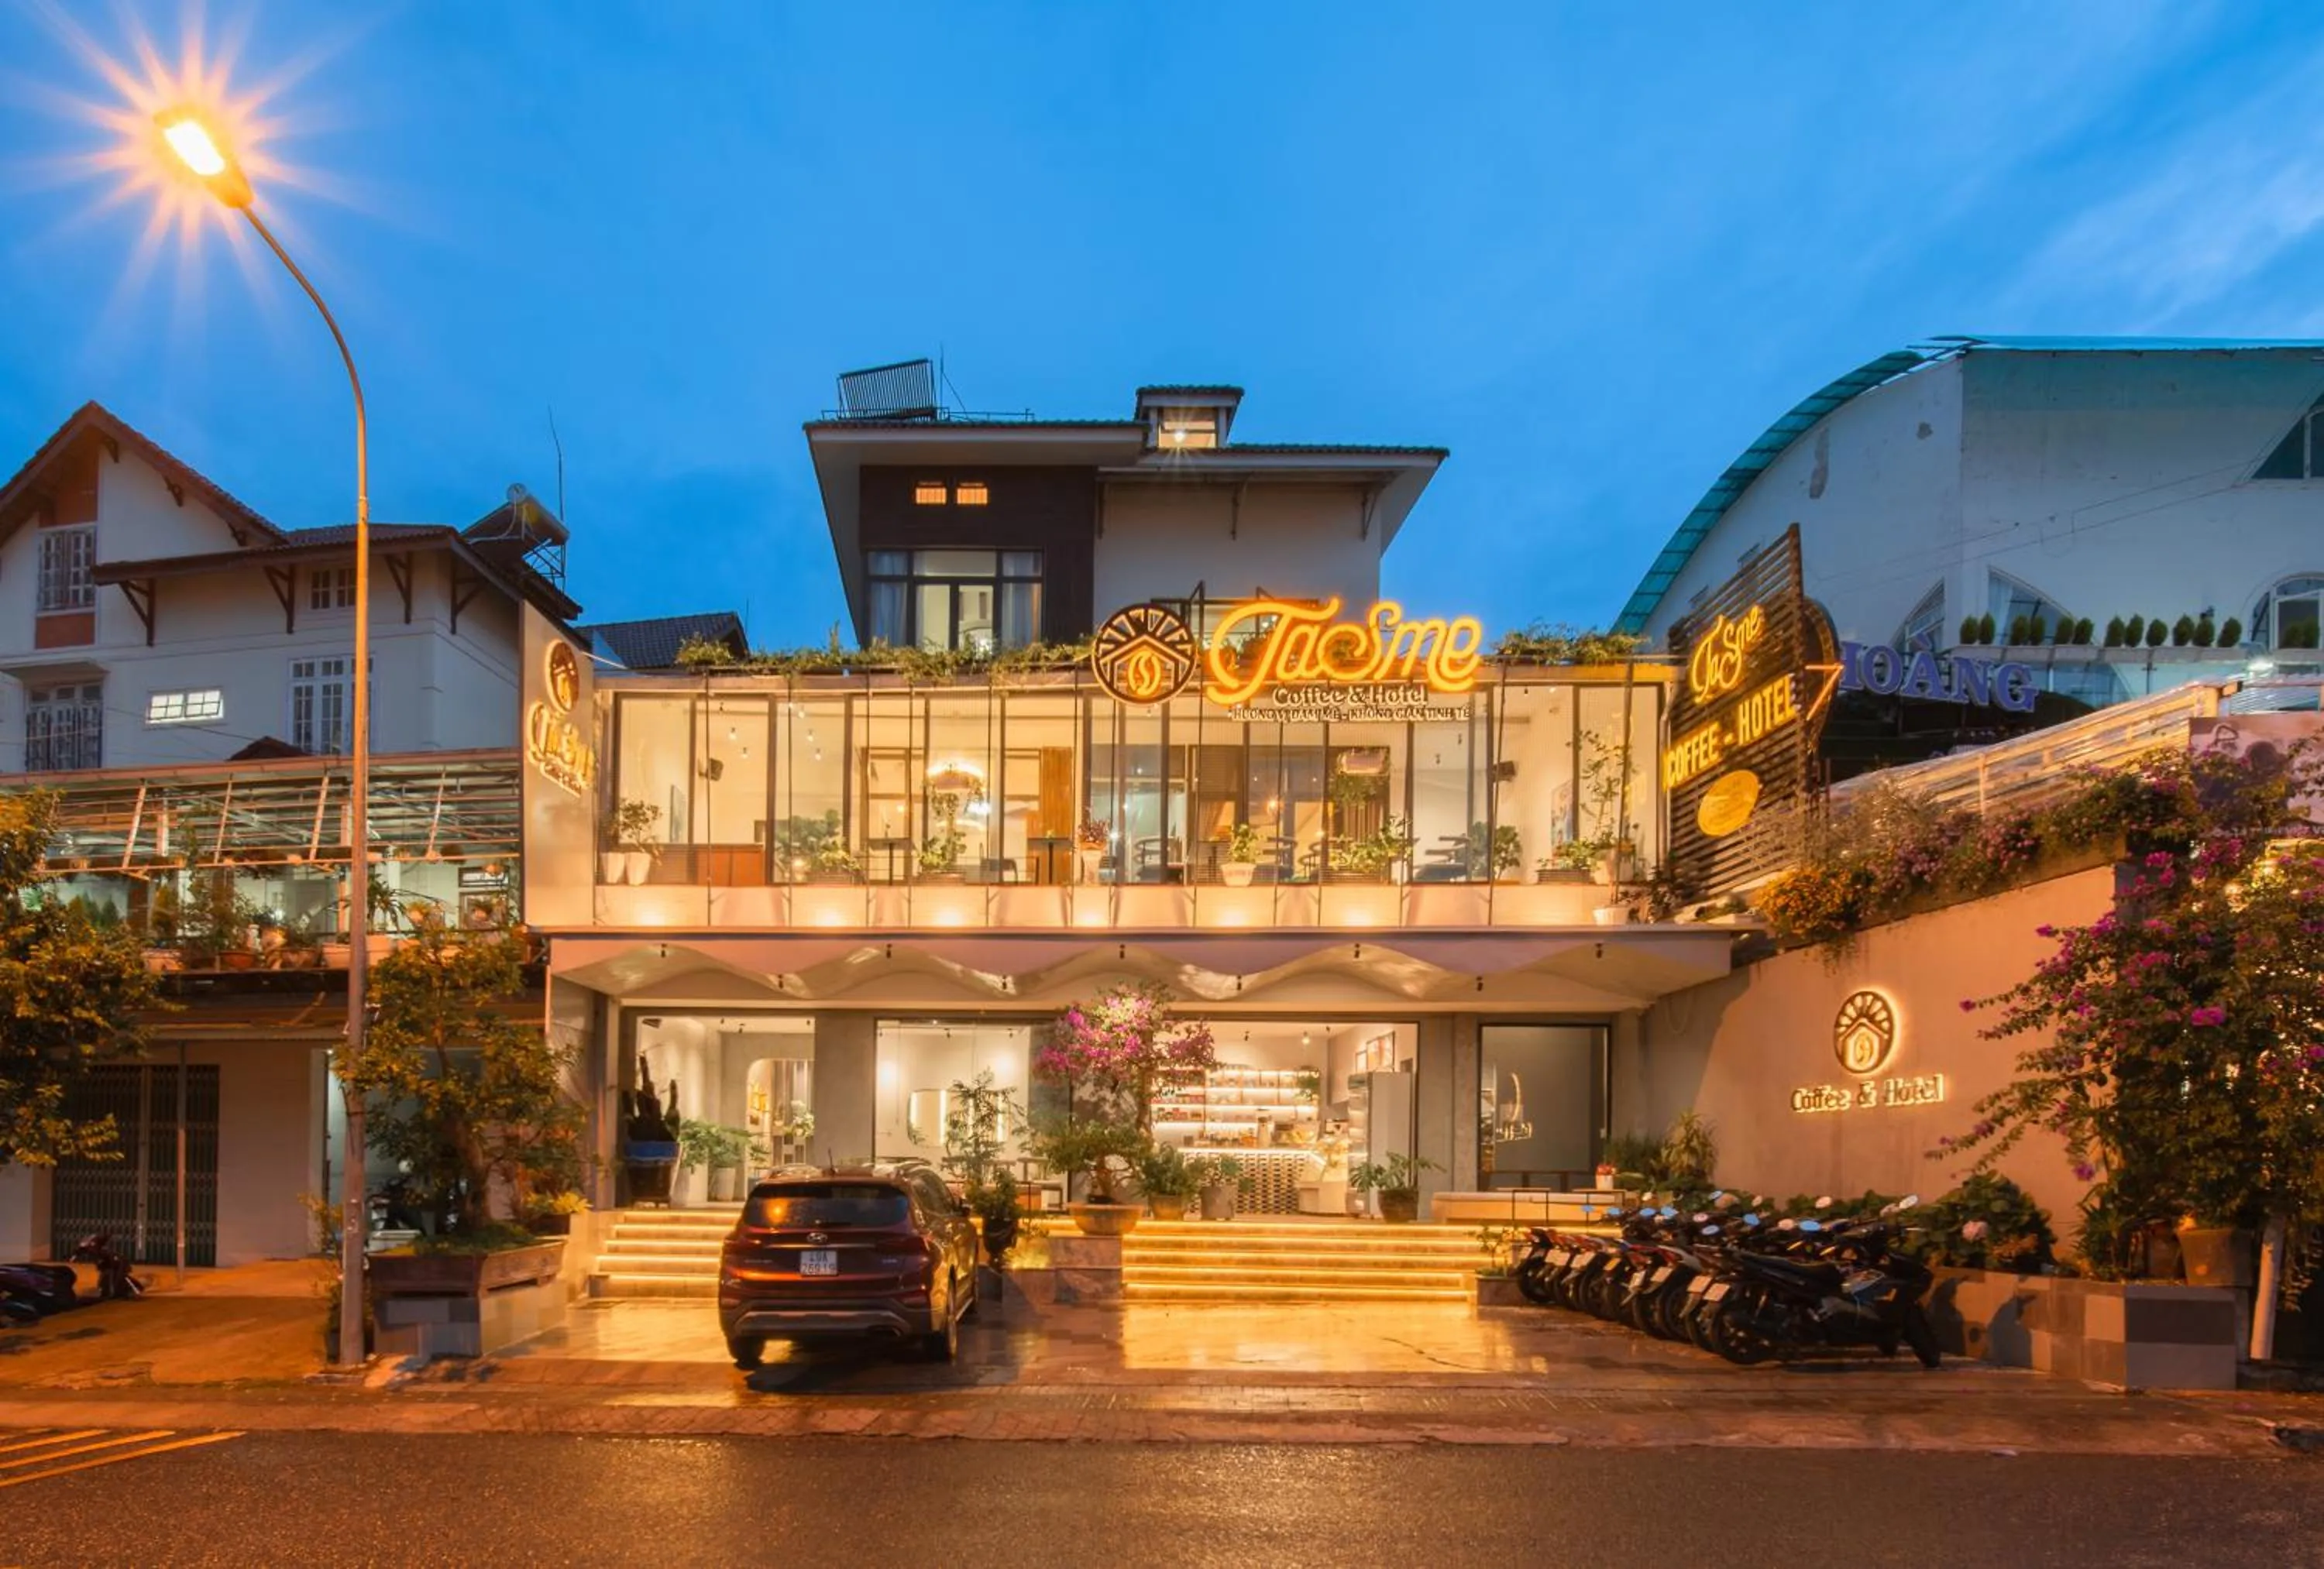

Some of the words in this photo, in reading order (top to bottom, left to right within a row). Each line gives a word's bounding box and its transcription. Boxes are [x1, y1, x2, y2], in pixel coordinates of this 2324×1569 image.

[1273, 687, 1346, 706] Coffee
[1347, 685, 1367, 706] &
[1369, 685, 1428, 706] Hotel
[1665, 722, 1719, 790] COFFEE
[1738, 674, 1798, 745] HOTEL
